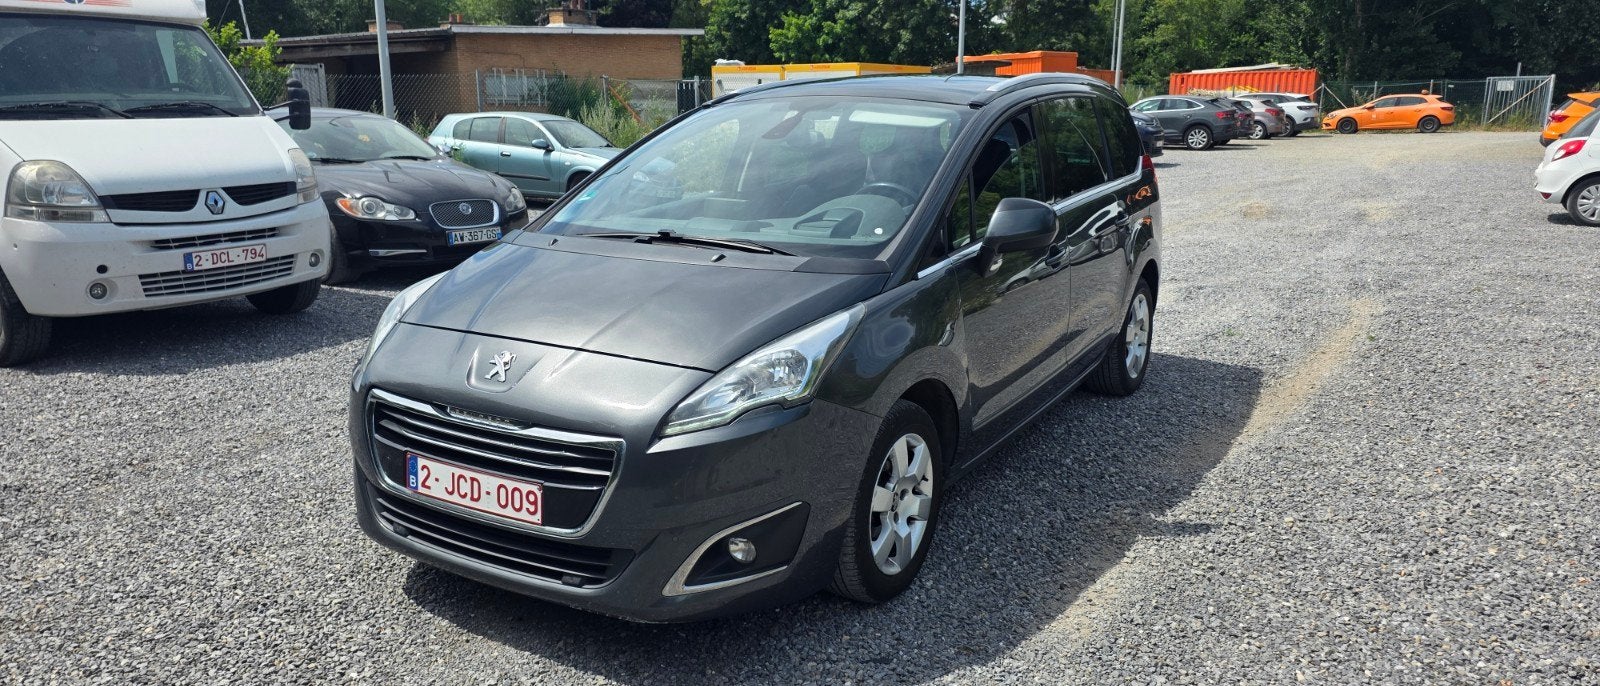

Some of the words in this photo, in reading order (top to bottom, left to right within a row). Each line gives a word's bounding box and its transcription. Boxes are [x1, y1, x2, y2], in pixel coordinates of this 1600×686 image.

[453, 229, 497, 243] AW-367-GS
[409, 475, 417, 488] B
[421, 464, 539, 516] 2-JCD-009
